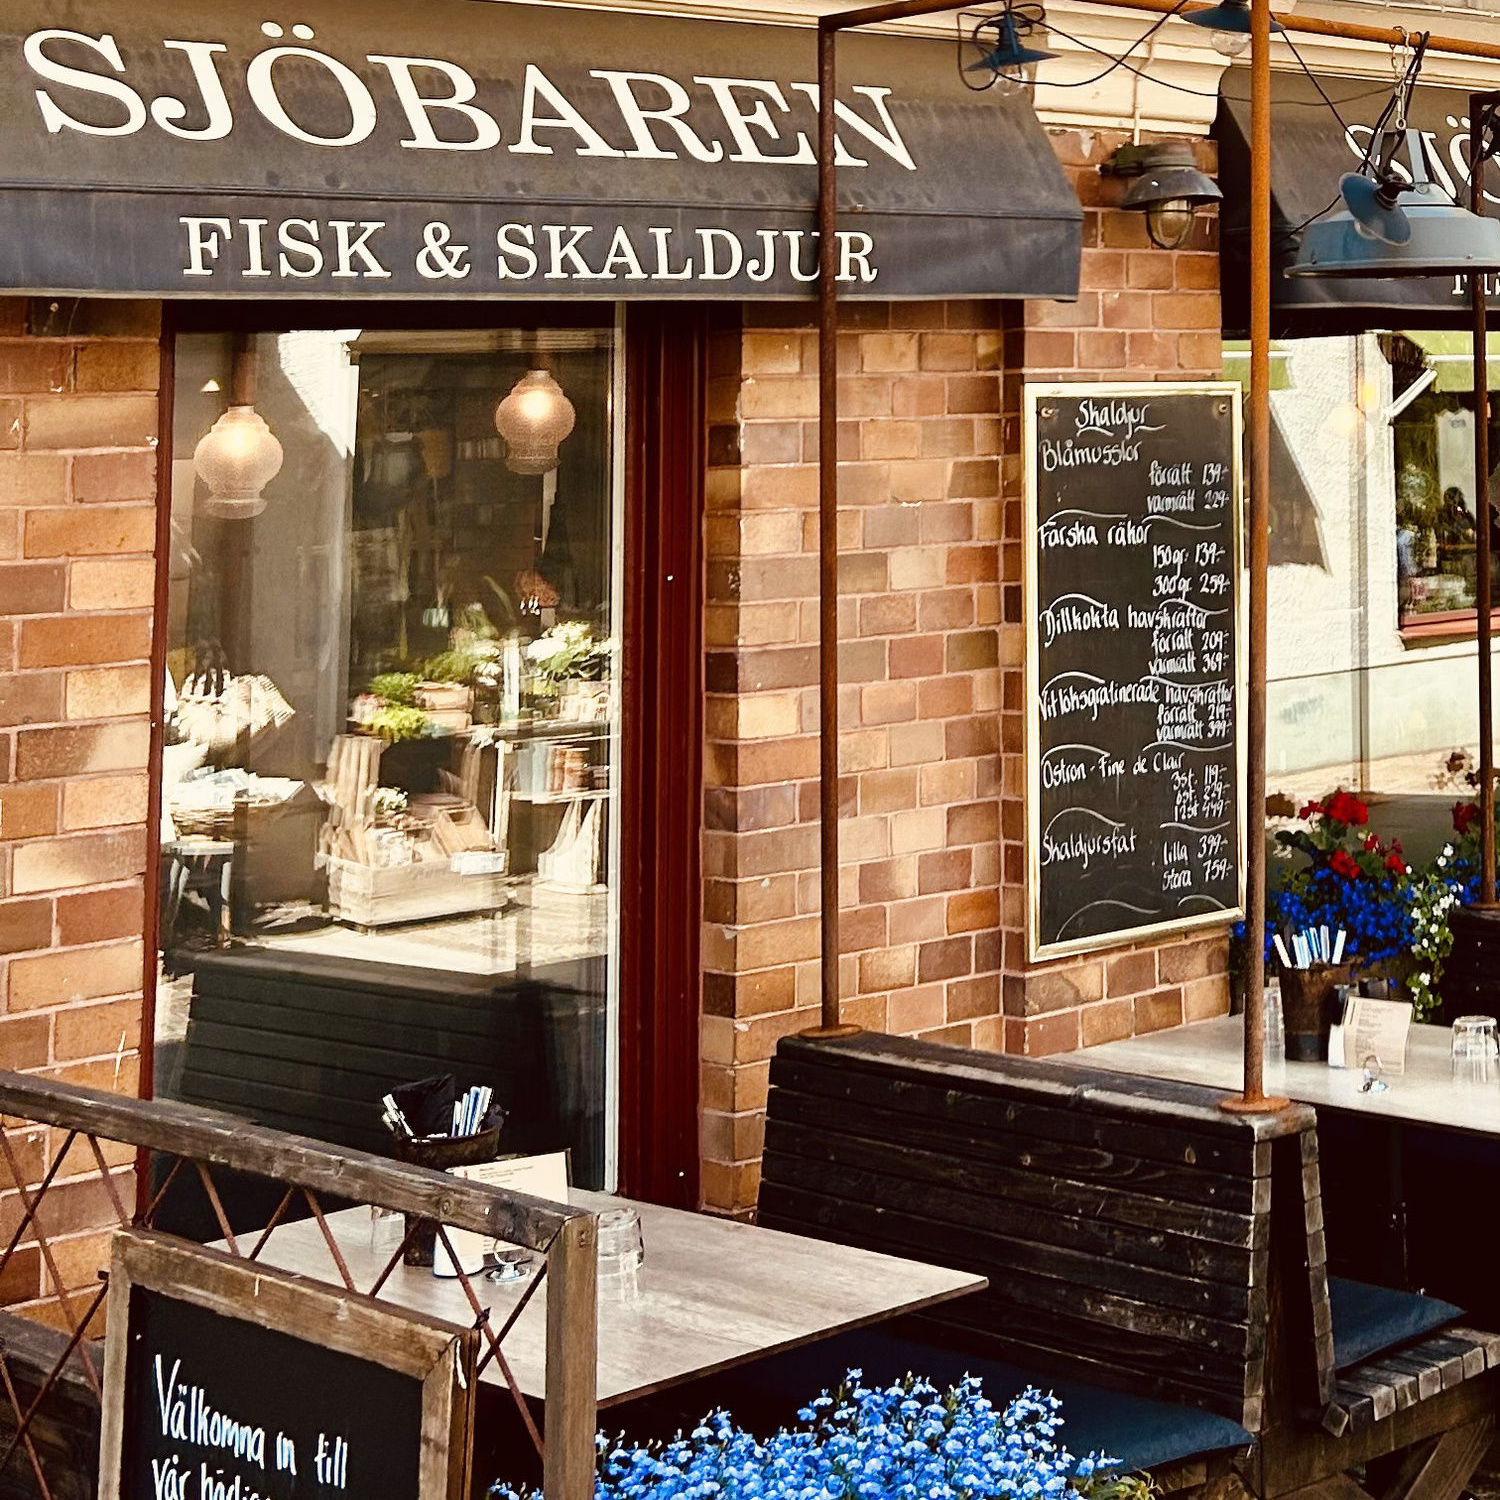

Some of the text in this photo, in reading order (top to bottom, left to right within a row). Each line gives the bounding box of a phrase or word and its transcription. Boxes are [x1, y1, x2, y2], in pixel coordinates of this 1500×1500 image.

[22, 21, 917, 171] SJÖBAREN
[180, 216, 878, 283] FISK & SKALDJUR
[1075, 399, 1151, 440] Skaldjur
[1040, 439, 1143, 471] Blåmusslor
[1148, 460, 1192, 486] förrätt
[1146, 489, 1195, 513] varmrätt
[1037, 521, 1152, 549] Färska räkor
[1040, 604, 1119, 648] Dillkokta
[1043, 757, 1086, 788] Ostron
[1098, 754, 1125, 783] Fine
[1132, 755, 1148, 775] de
[154, 1353, 265, 1470] Välkomna
[276, 1431, 297, 1476] in
[314, 1433, 349, 1489] till
